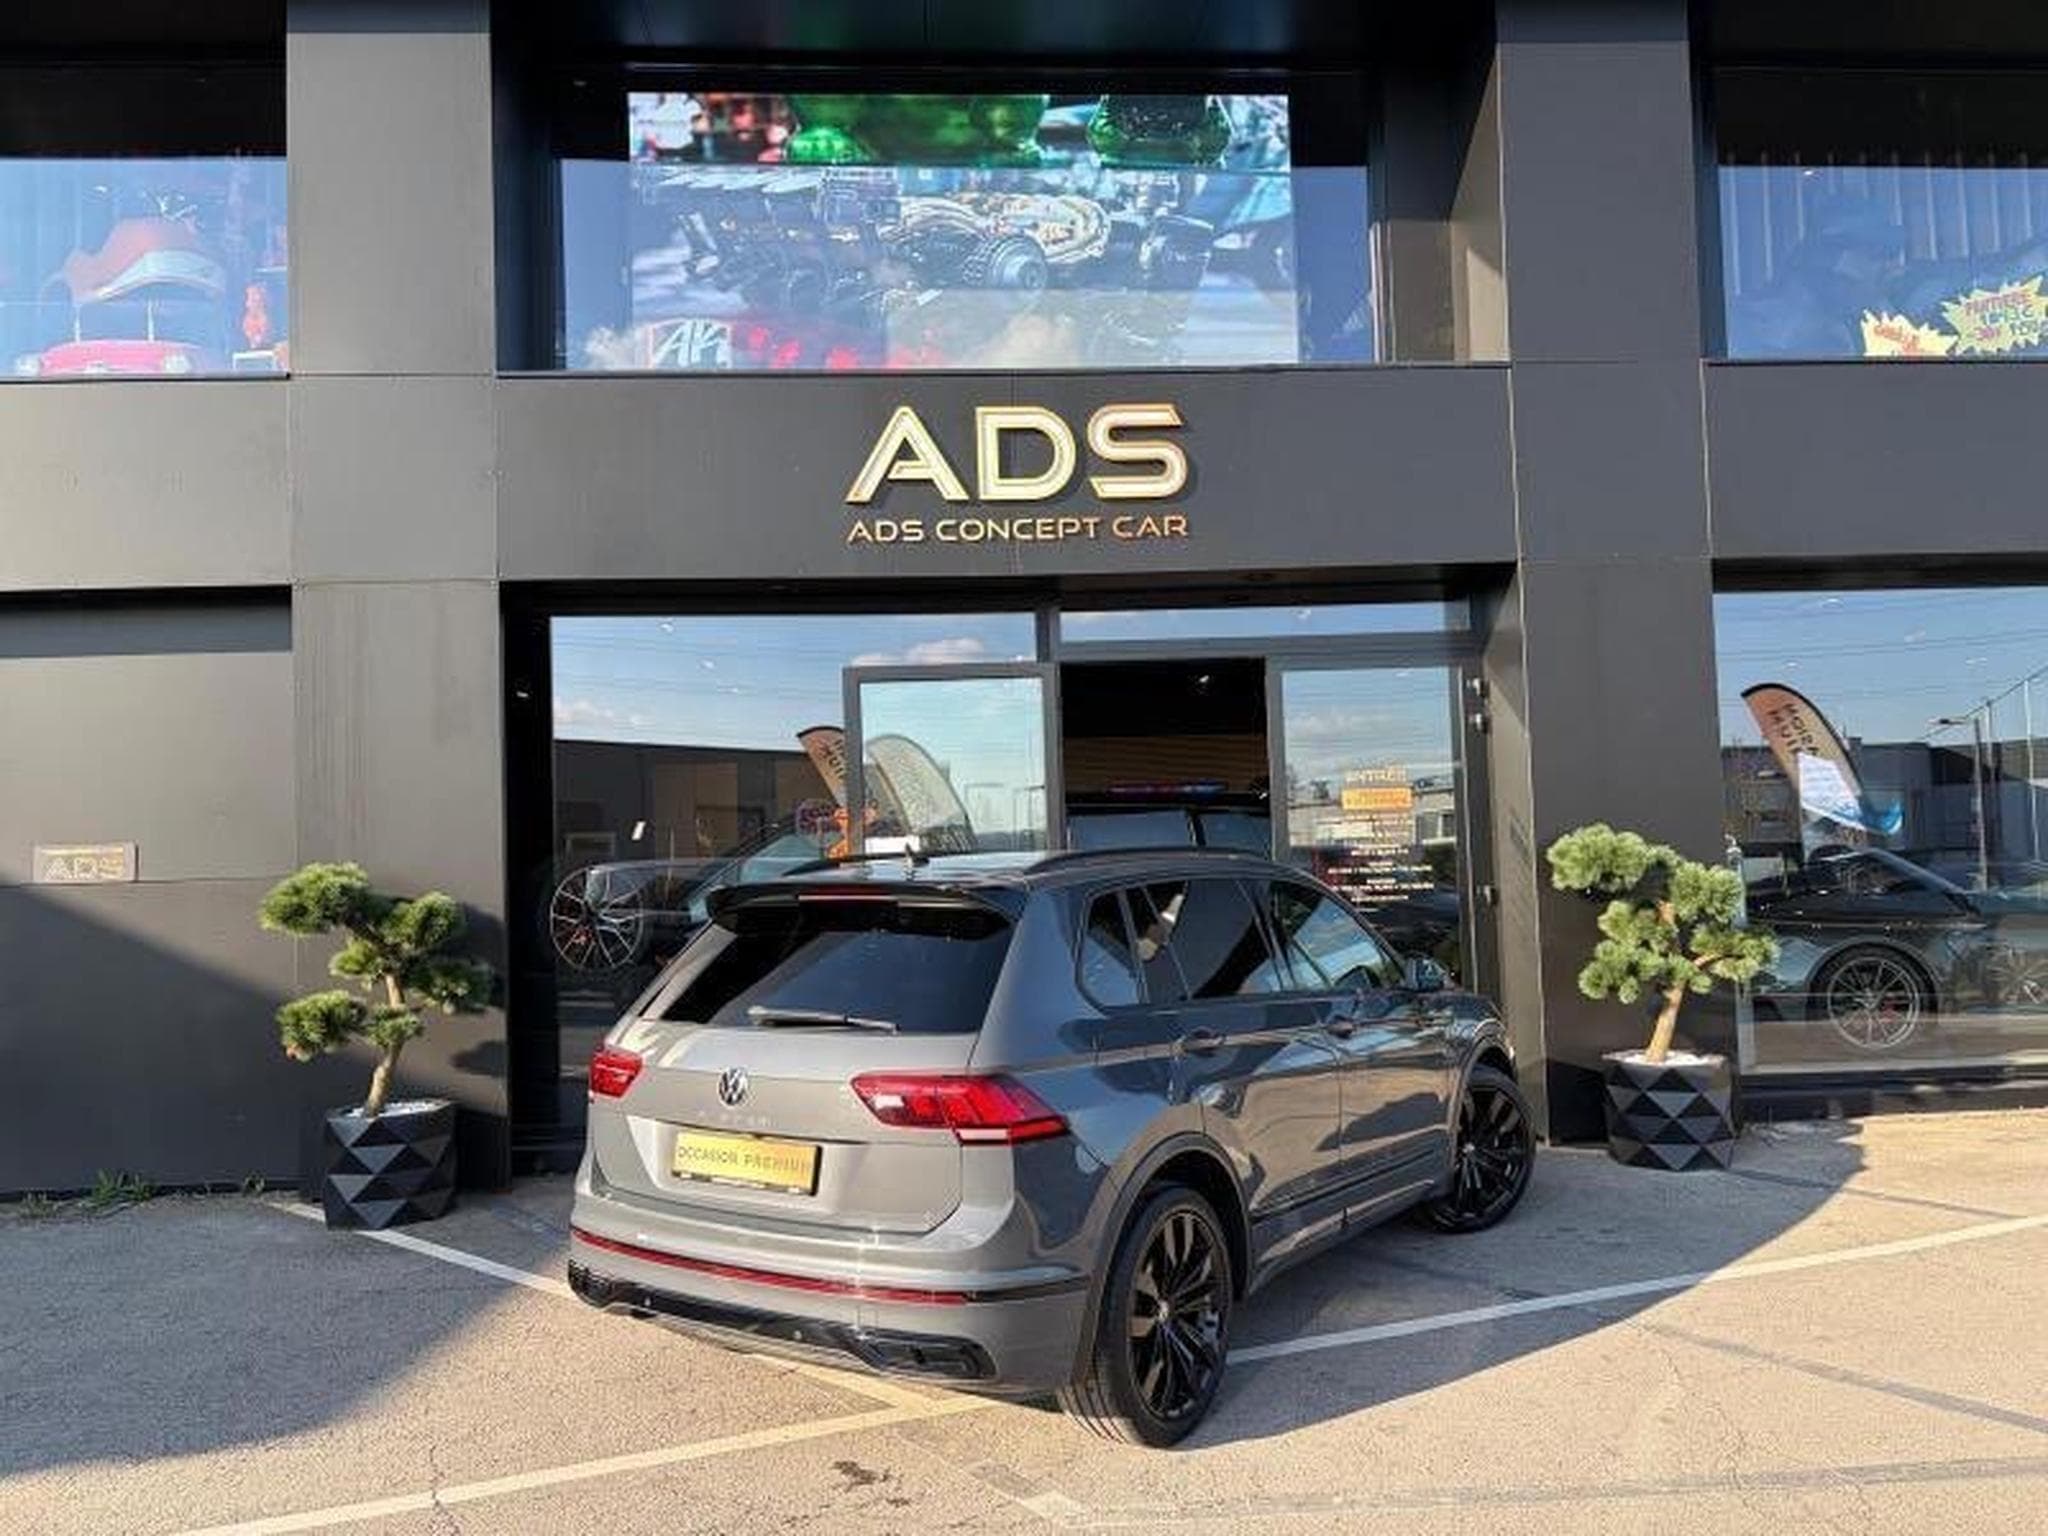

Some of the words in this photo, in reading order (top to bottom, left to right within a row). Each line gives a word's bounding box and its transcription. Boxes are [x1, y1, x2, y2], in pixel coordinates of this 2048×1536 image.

[845, 403, 1188, 502] ADS
[846, 518, 925, 543] ADS
[935, 516, 1101, 542] CONCEPT
[1112, 514, 1189, 540] CAR
[46, 856, 125, 881] ADS
[678, 1146, 739, 1166] OCCASION
[743, 1153, 808, 1174] PREMIUM
